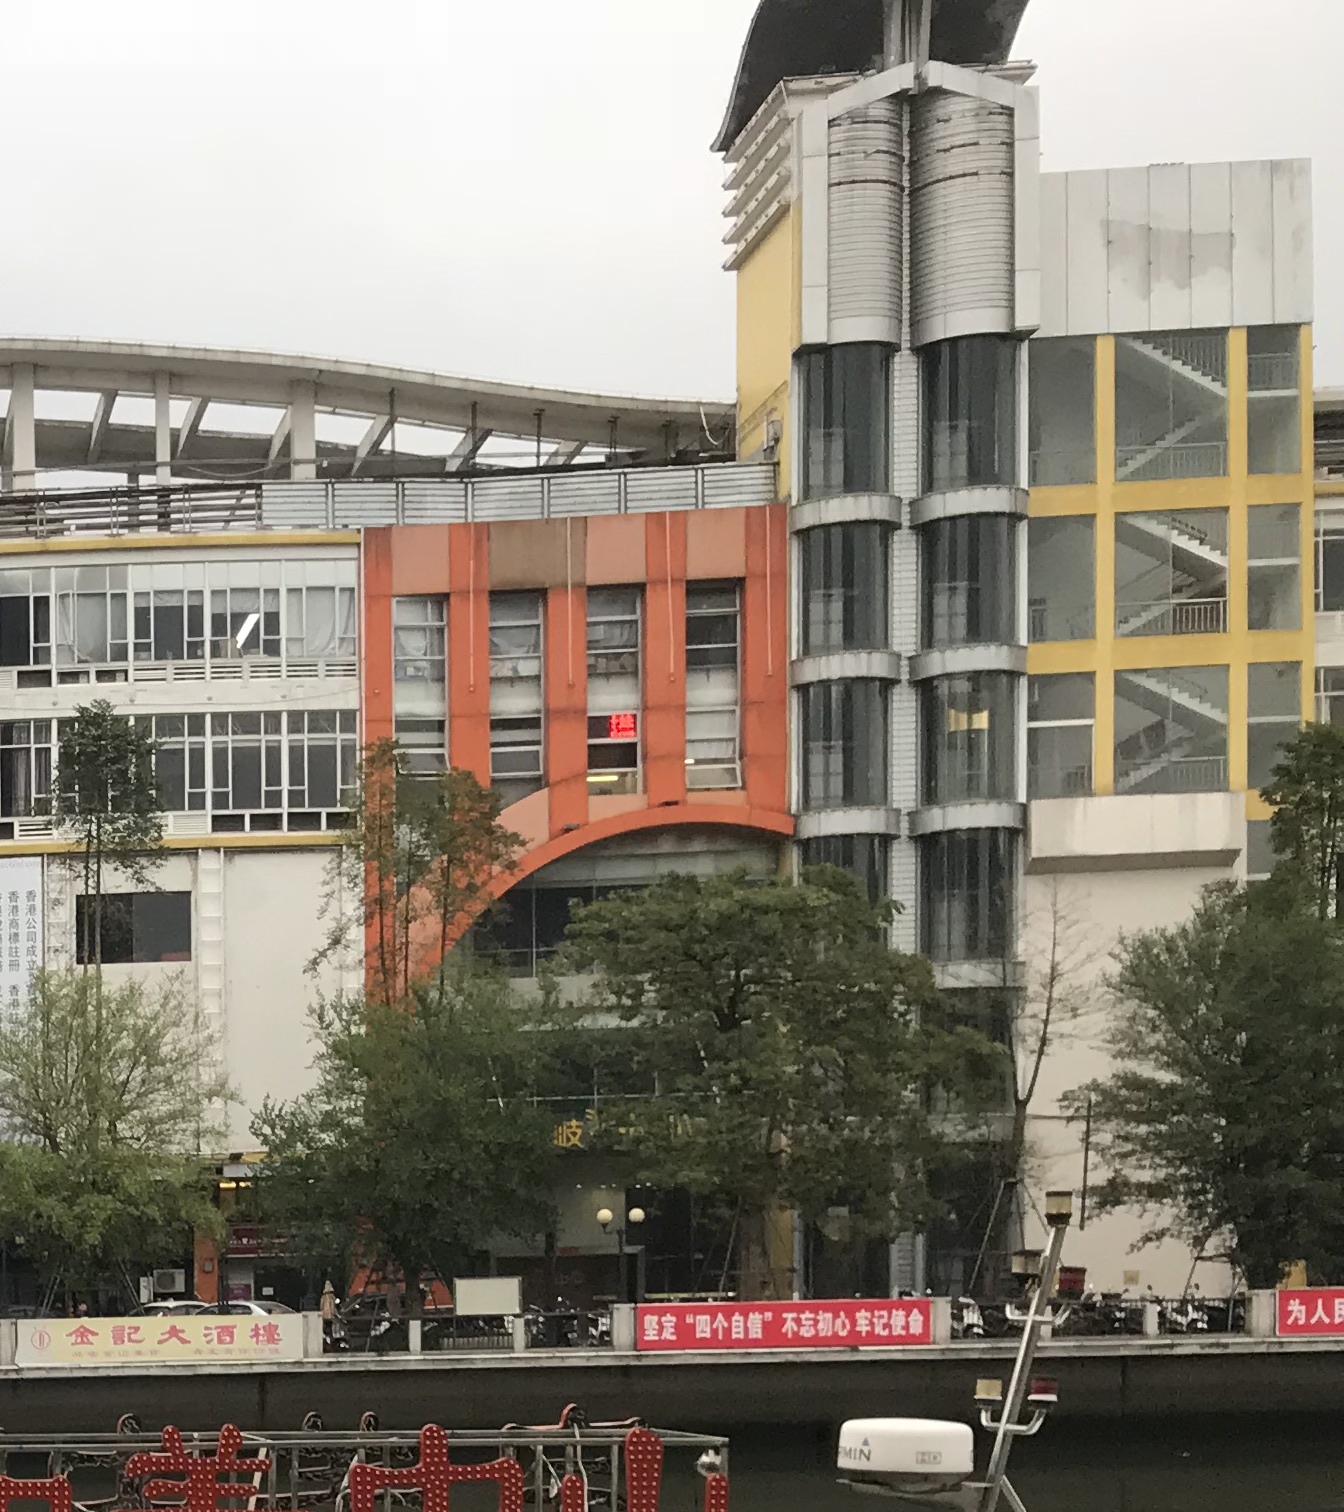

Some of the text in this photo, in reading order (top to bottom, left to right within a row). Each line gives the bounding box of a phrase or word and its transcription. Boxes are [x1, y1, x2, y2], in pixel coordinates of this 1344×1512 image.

[781, 1310, 850, 1339] 不忘初心
[855, 1308, 925, 1338] 牢记使命
